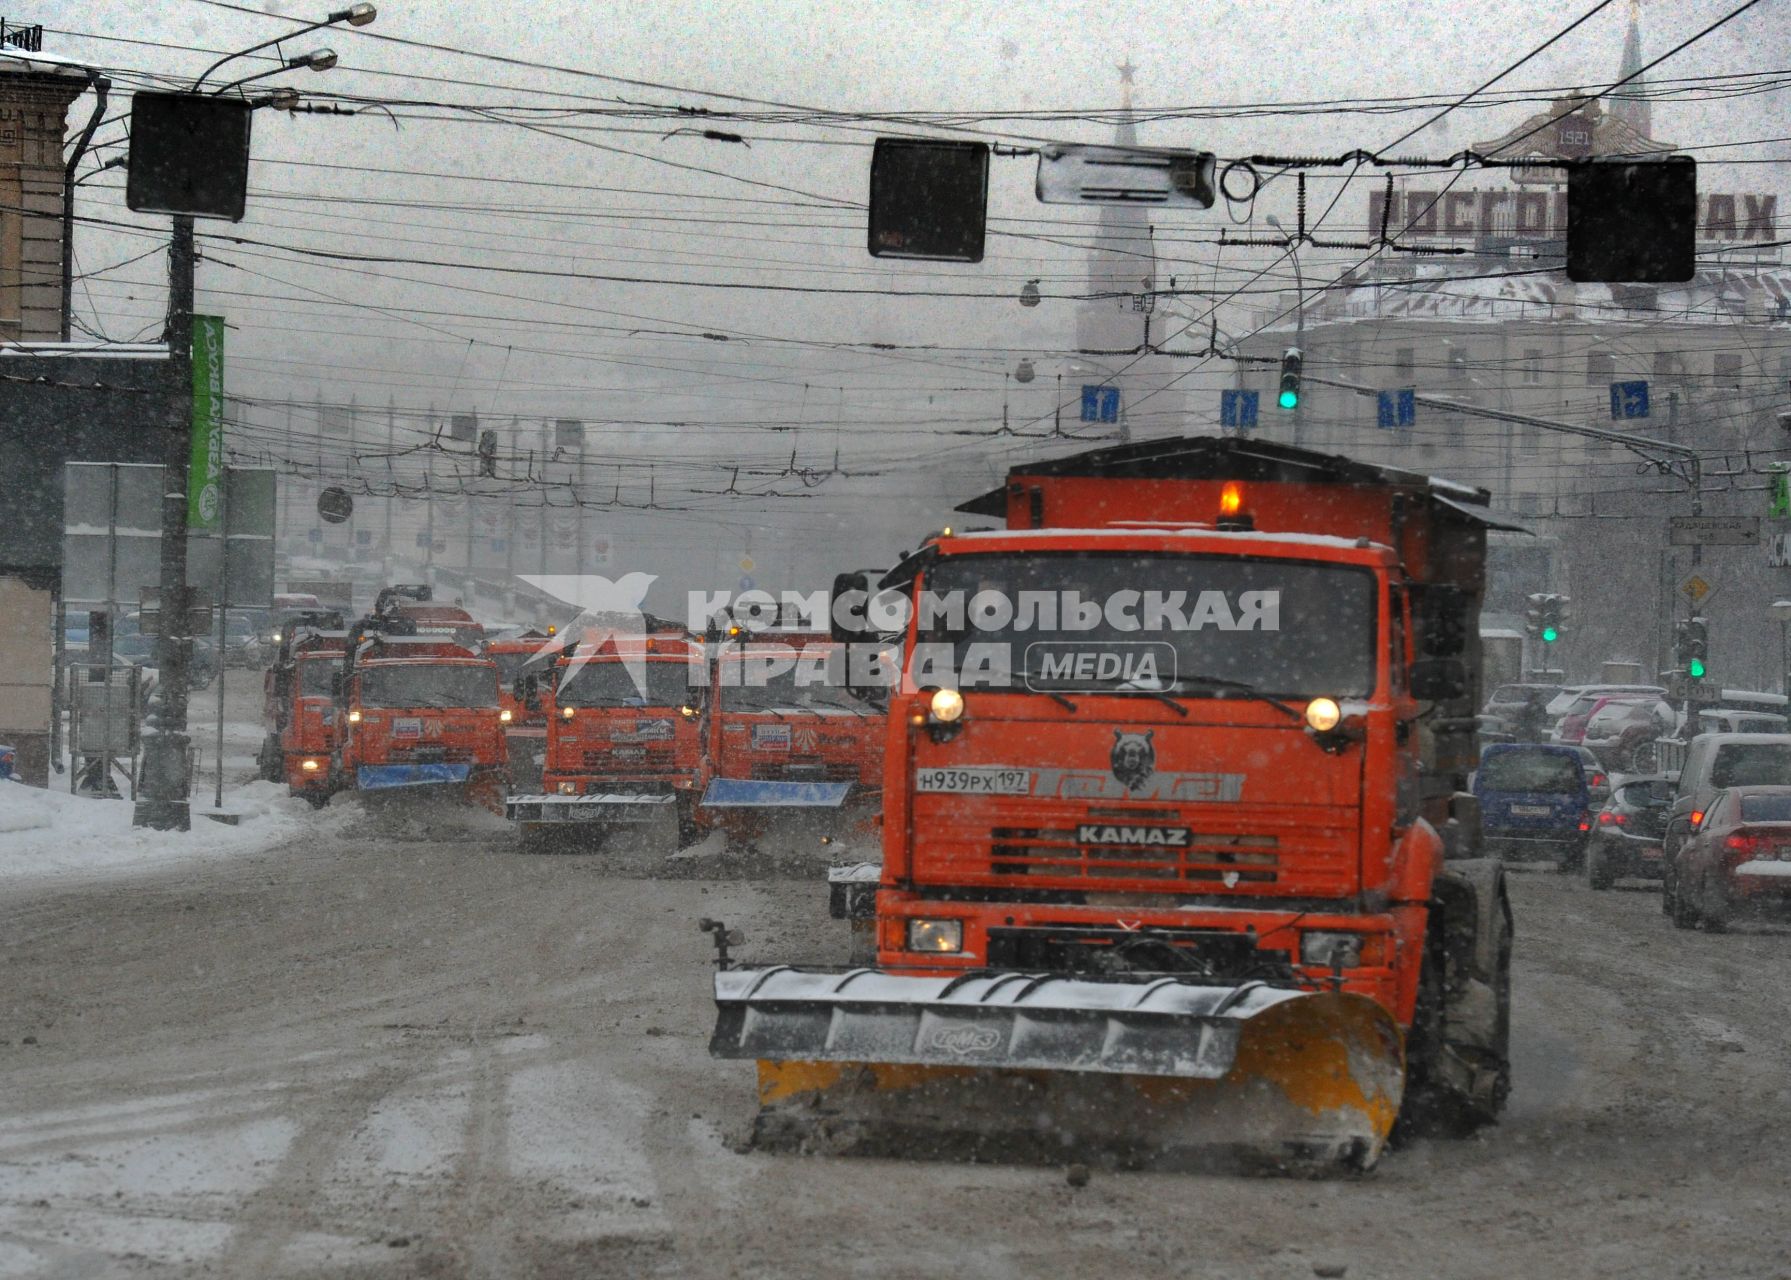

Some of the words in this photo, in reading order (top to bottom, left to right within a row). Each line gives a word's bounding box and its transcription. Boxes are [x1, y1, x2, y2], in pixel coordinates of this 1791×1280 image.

[922, 771, 993, 791] Н939РХ
[999, 771, 1025, 787] 197
[1080, 826, 1188, 845] KAMAZ
